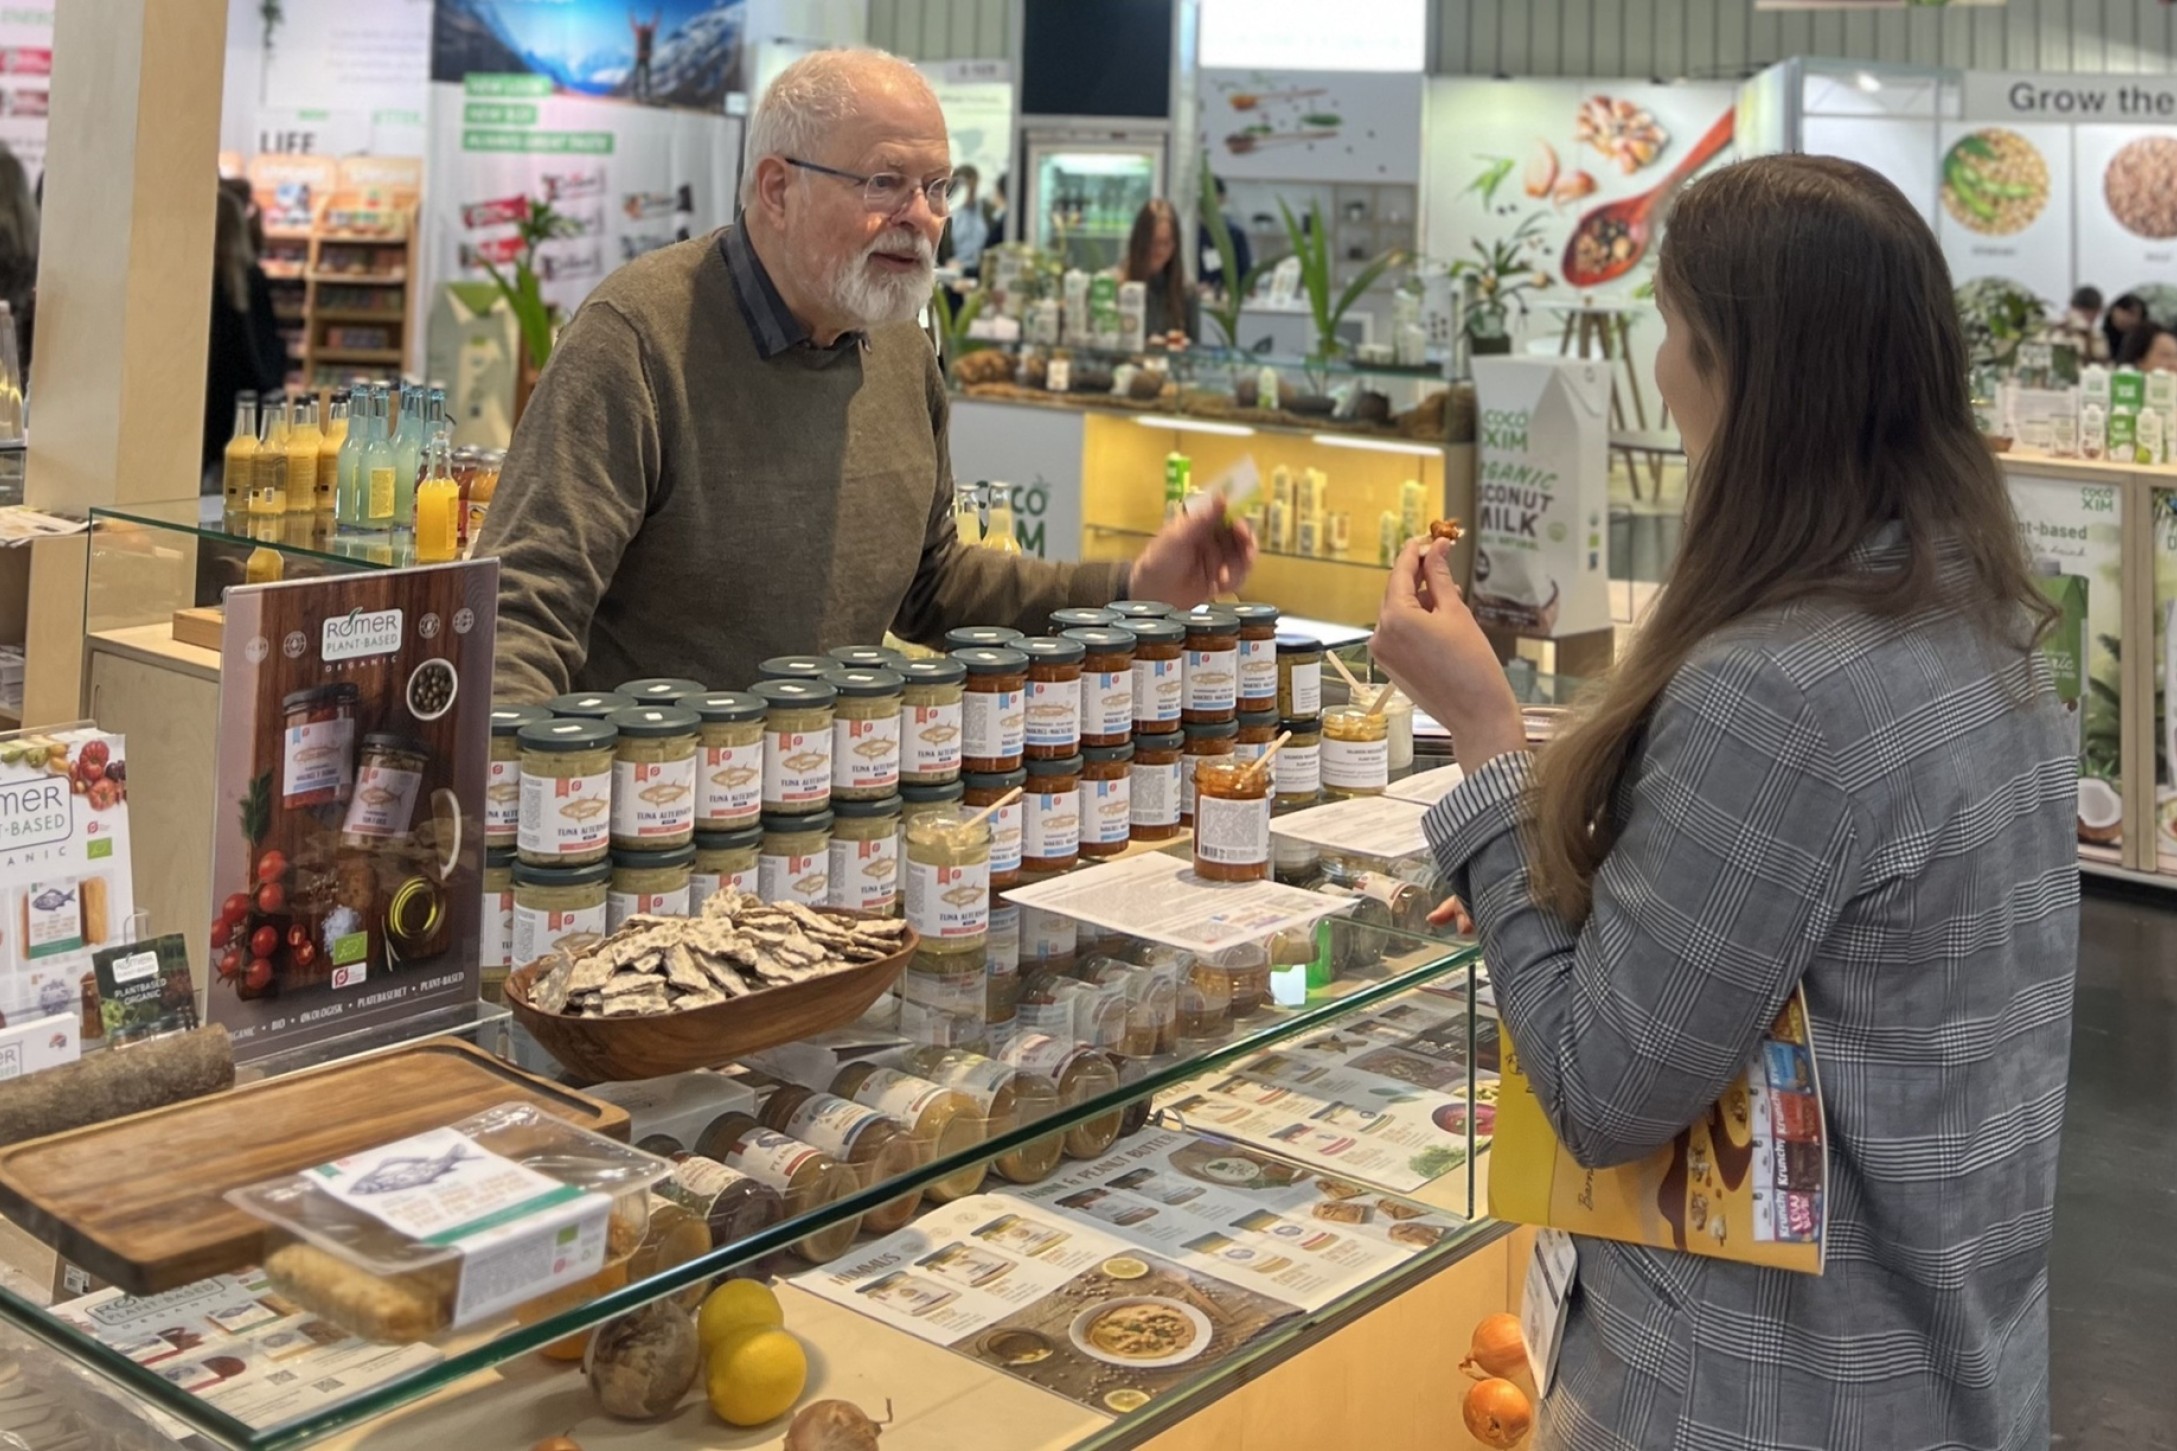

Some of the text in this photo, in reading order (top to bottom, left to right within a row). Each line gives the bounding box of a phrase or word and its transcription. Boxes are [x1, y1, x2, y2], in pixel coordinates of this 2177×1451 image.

[2009, 81, 2176, 116] Grow the
[1483, 407, 1528, 429] COCO
[1480, 429, 1529, 452] XIM
[2081, 499, 2114, 513] XIM
[2016, 521, 2089, 542] nt-based
[325, 633, 399, 653] PLANT-BASED
[324, 655, 397, 673] ORGANIC
[852, 764, 870, 773] TUNA
[781, 778, 800, 787] TUNA
[0, 785, 64, 817] meR
[708, 794, 728, 803] TUNA
[636, 811, 657, 820] TUNA
[557, 827, 579, 837] TUNA
[7, 845, 67, 867] ANIC
[861, 885, 878, 894] TUNA
[939, 912, 959, 921] TUNA
[114, 977, 168, 998] PLANTBASED
[124, 988, 162, 1005] ORGANIC
[228, 1026, 256, 1041] GANIC
[271, 1017, 286, 1031] BIO
[419, 971, 465, 992] PLANT-BASED
[1769, 1087, 1788, 1135] Krunchy
[1076, 1155, 1132, 1181] PEANUT
[1775, 1136, 1789, 1187] Krunchy
[1775, 1187, 1790, 1239] Krunchy
[1789, 1193, 1802, 1232] LOW
[828, 1252, 902, 1286] HUMMUS
